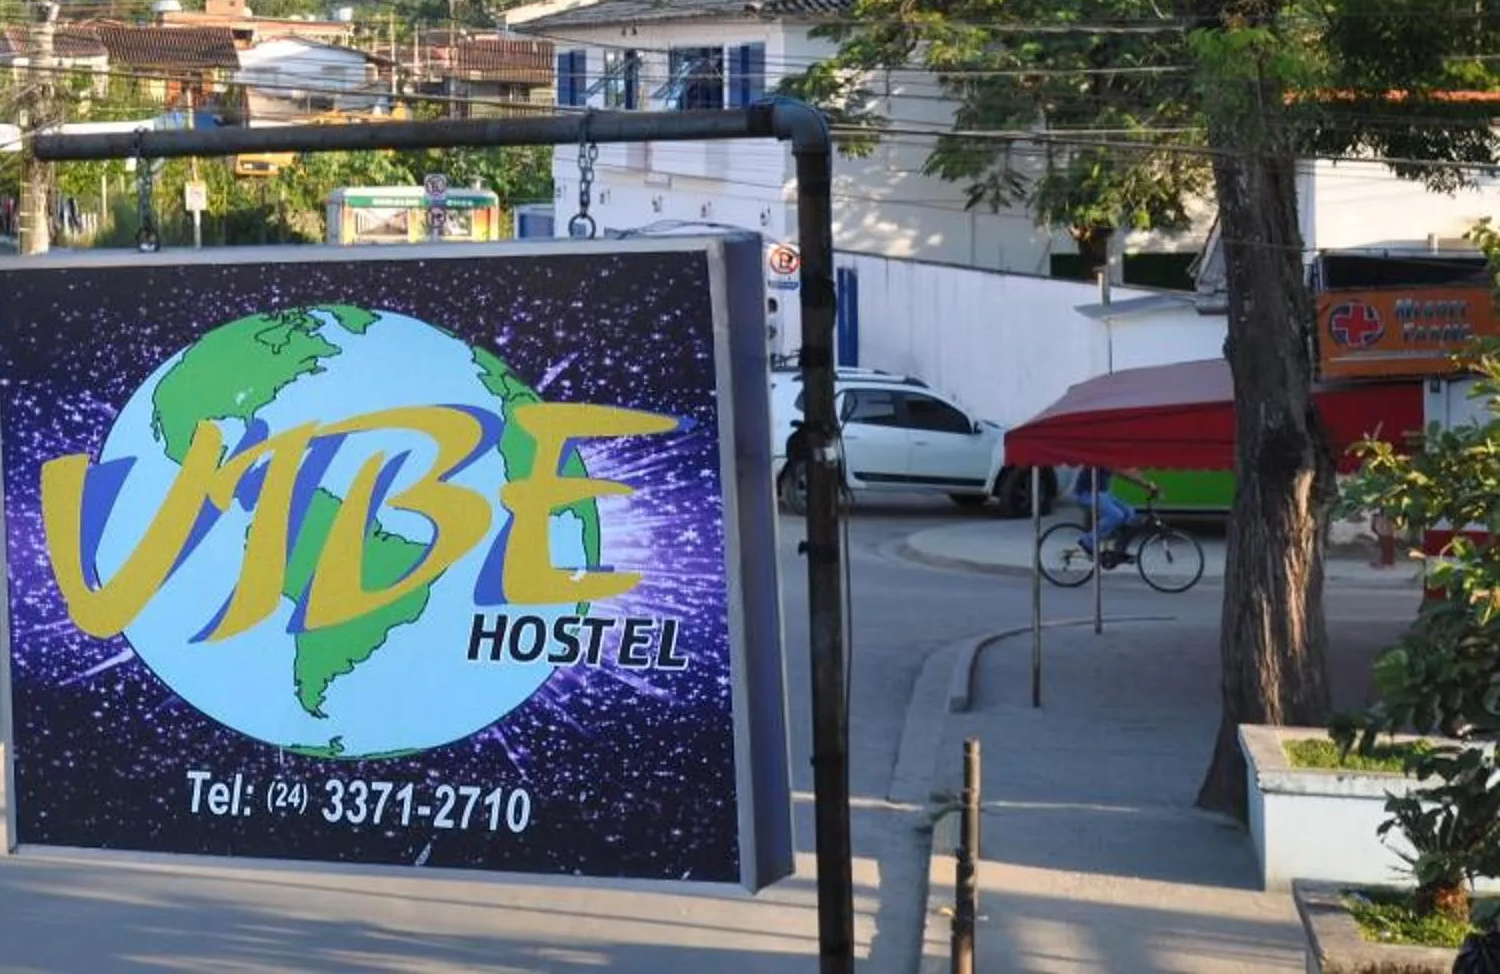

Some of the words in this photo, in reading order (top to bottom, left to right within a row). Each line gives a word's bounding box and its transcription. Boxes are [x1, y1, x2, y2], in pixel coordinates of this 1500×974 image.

[41, 402, 690, 644] VIBE
[467, 613, 688, 669] HOSTEL
[186, 771, 253, 816] Tel:
[267, 783, 308, 814] (24)
[321, 778, 532, 832] 3371-2710
